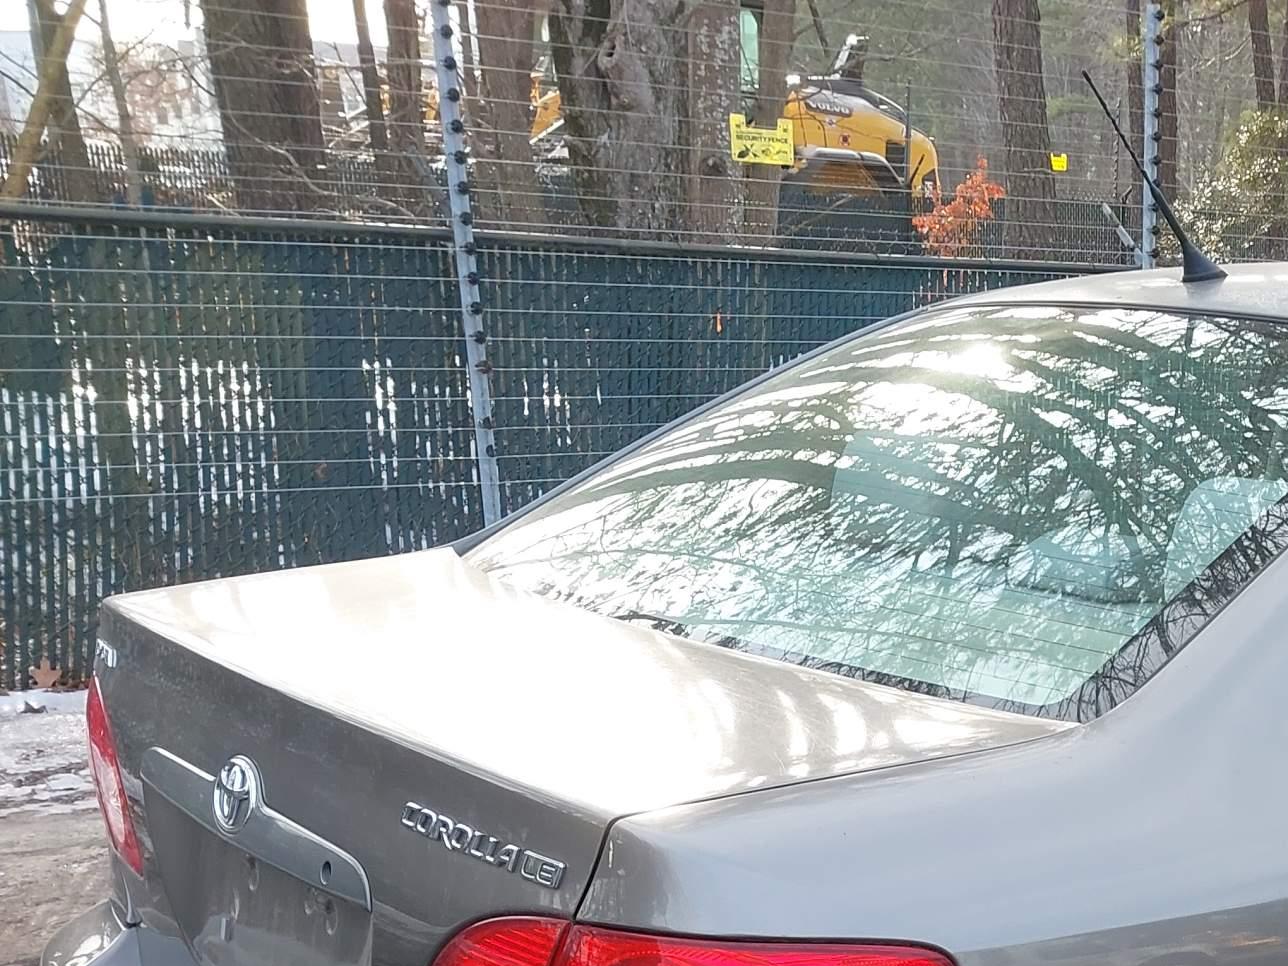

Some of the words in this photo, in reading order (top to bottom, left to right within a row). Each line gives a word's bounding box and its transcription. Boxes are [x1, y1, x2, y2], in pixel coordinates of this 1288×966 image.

[807, 100, 849, 114] VOLVO
[400, 801, 520, 873] COROLLA
[520, 850, 566, 890] LE
